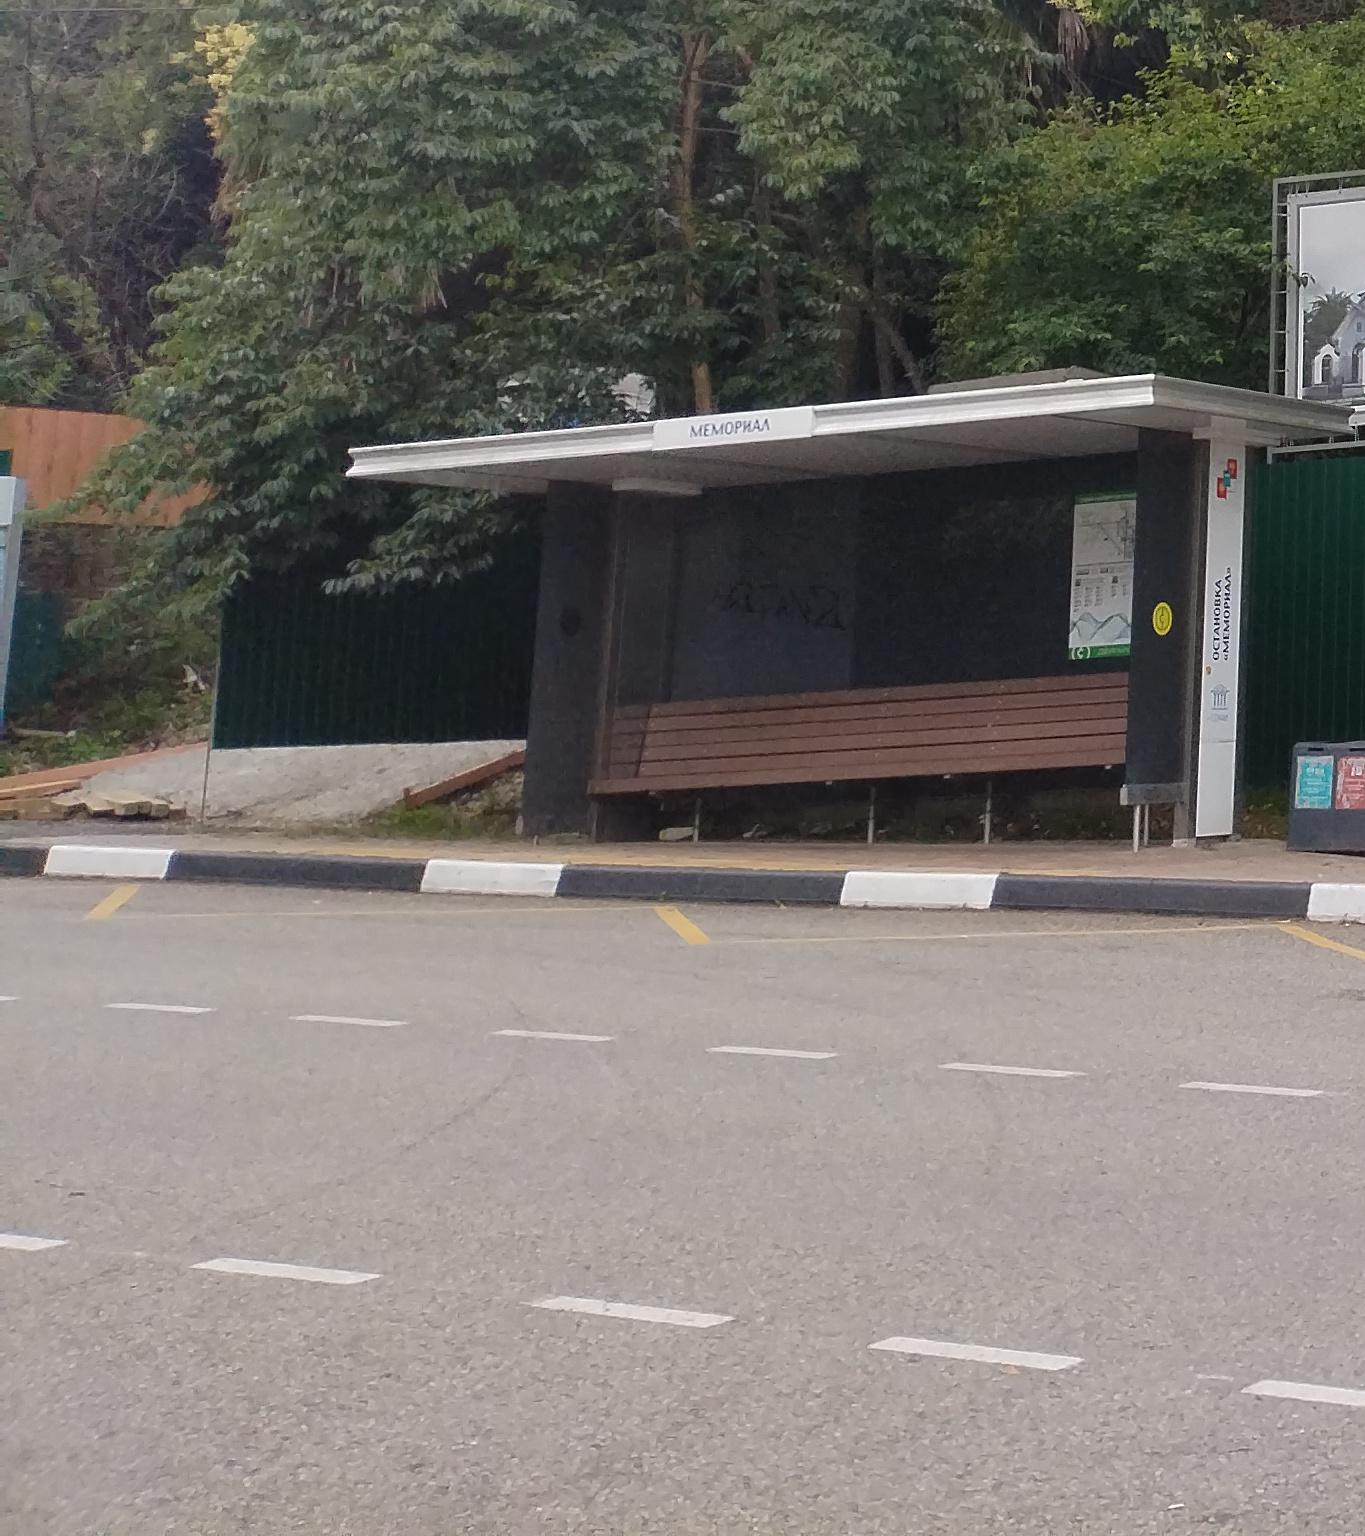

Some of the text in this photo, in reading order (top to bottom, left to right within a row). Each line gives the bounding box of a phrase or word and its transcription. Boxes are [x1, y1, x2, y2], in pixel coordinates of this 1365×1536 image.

[689, 418, 770, 438] МЕМОРИАЛ
[1212, 579, 1222, 661] ОСТАНОВКА
[1222, 567, 1232, 661] «МЕМОРИАЛ»
